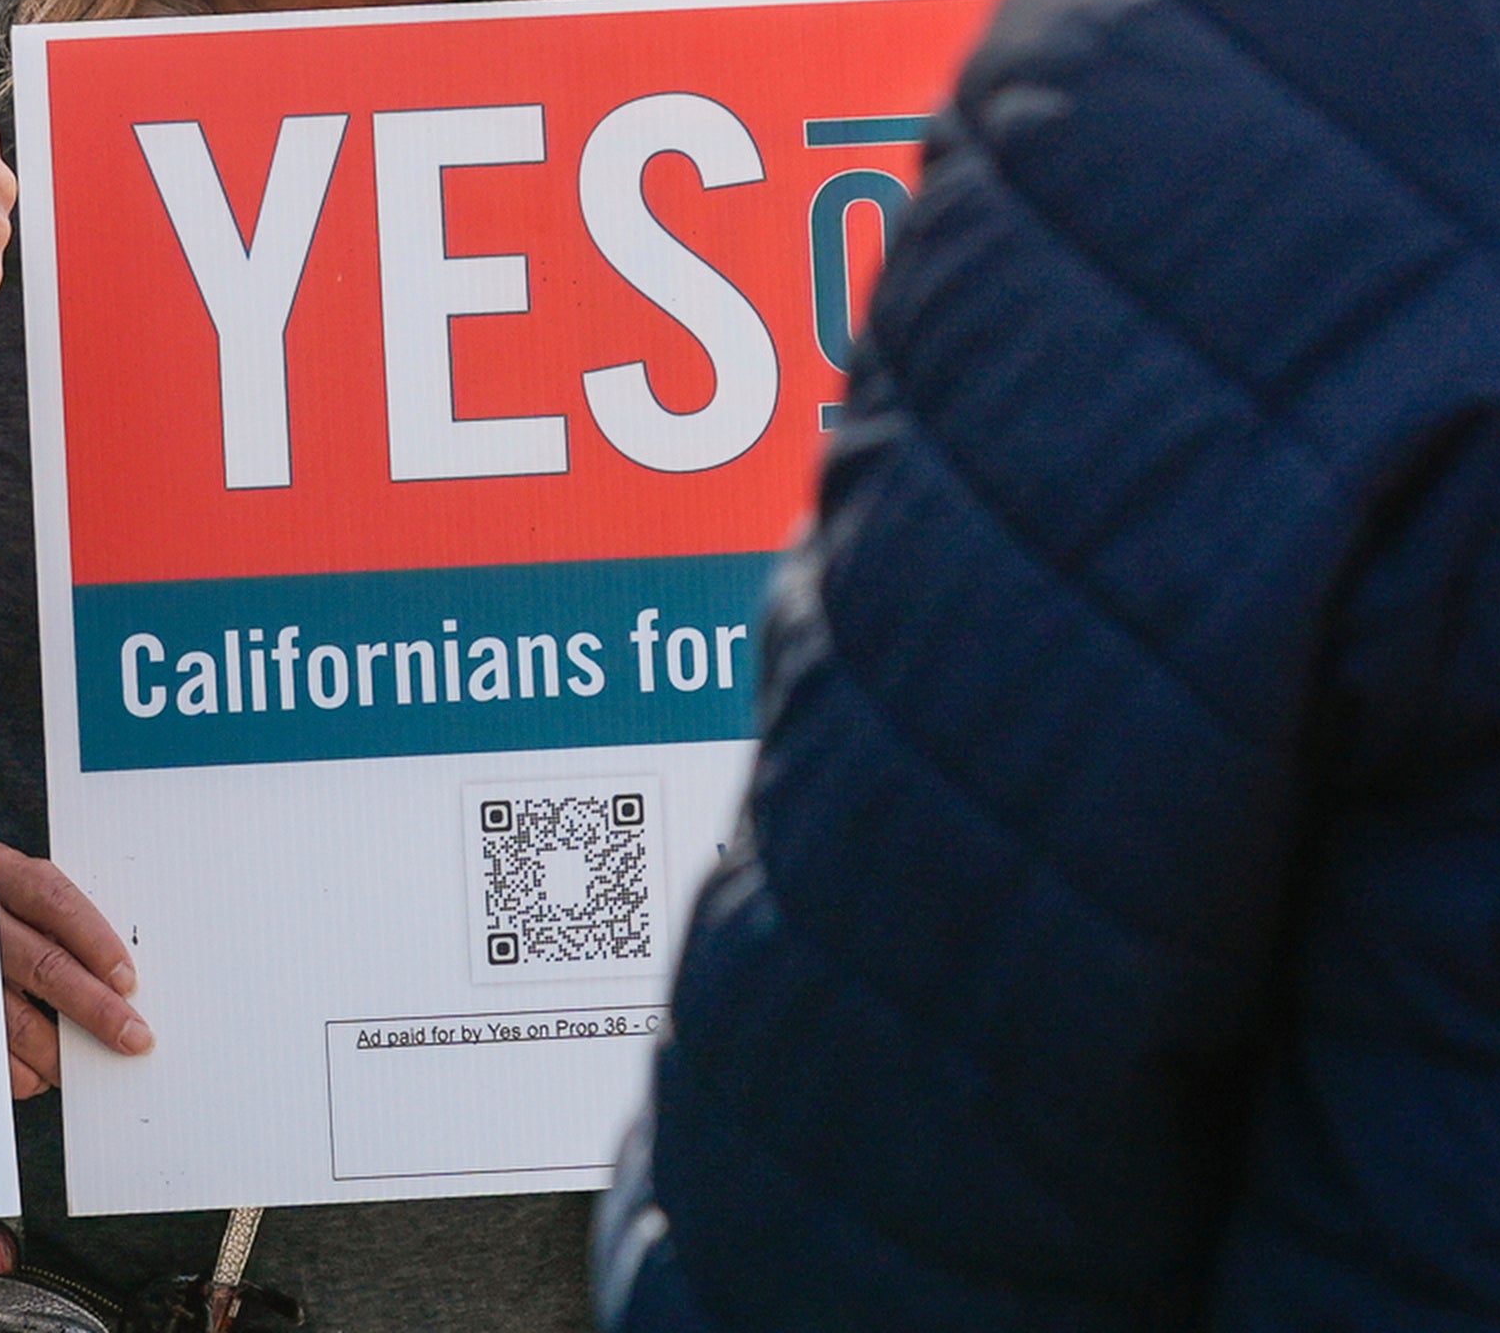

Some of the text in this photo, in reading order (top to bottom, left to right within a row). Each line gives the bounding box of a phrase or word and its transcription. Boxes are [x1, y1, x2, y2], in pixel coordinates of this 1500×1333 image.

[131, 90, 916, 491] YES O
[119, 606, 749, 720] Californians for
[356, 1029, 383, 1048] Ad
[387, 1026, 427, 1049] paid
[431, 1026, 456, 1045] for
[460, 1024, 483, 1046] by
[487, 1022, 522, 1041] Yes
[526, 1024, 550, 1040] on
[555, 1018, 600, 1040] Prop
[603, 1016, 628, 1034] 36
